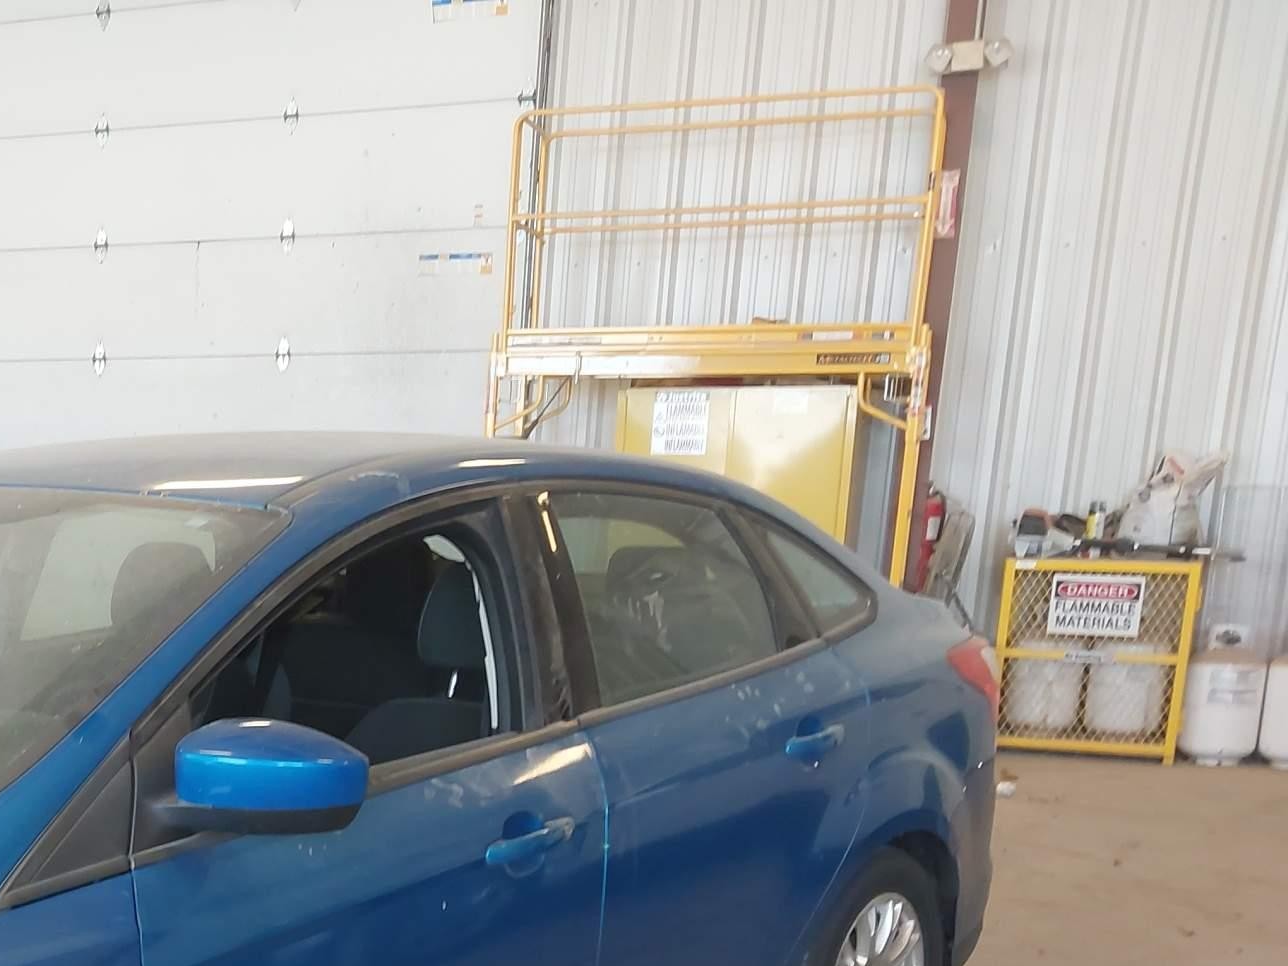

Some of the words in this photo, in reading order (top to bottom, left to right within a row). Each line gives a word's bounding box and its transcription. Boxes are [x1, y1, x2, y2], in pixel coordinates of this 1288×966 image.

[1066, 584, 1129, 598] DANGER
[1054, 601, 1136, 616] FLAMMABLE
[1054, 615, 1132, 631] MATERIALS
